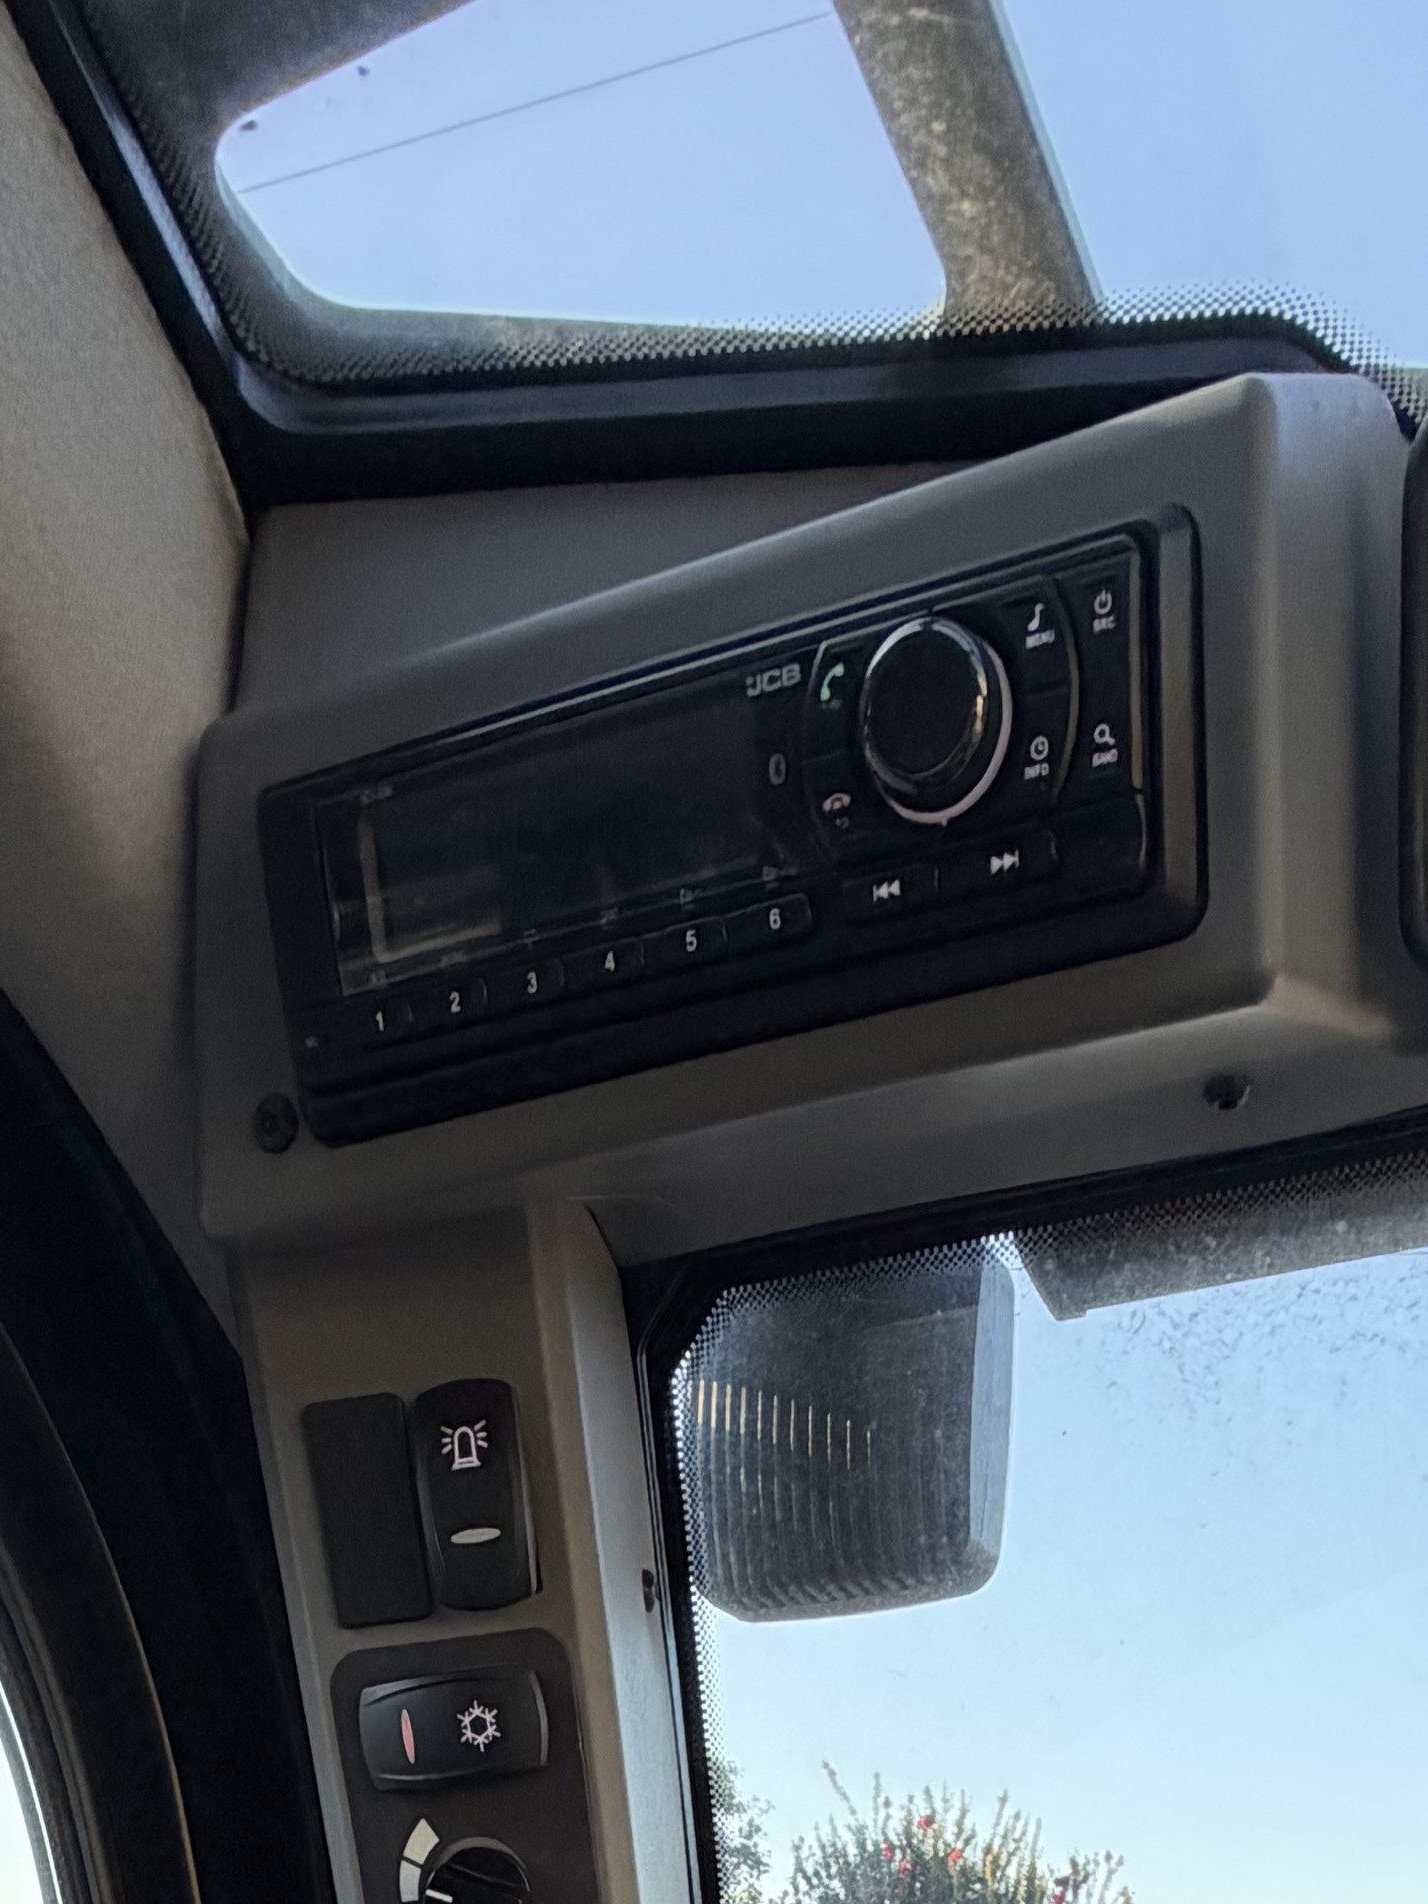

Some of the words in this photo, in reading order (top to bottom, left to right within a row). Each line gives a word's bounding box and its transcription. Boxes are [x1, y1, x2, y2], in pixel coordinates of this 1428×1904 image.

[1025, 630, 1055, 648] MENU
[746, 664, 801, 697] JCB
[1024, 762, 1050, 780] INFO
[375, 1011, 386, 1032] 1
[449, 992, 462, 1013] 2
[527, 972, 538, 993] 3
[604, 951, 616, 972] 4
[685, 931, 697, 952] 5
[768, 909, 781, 930] 6
